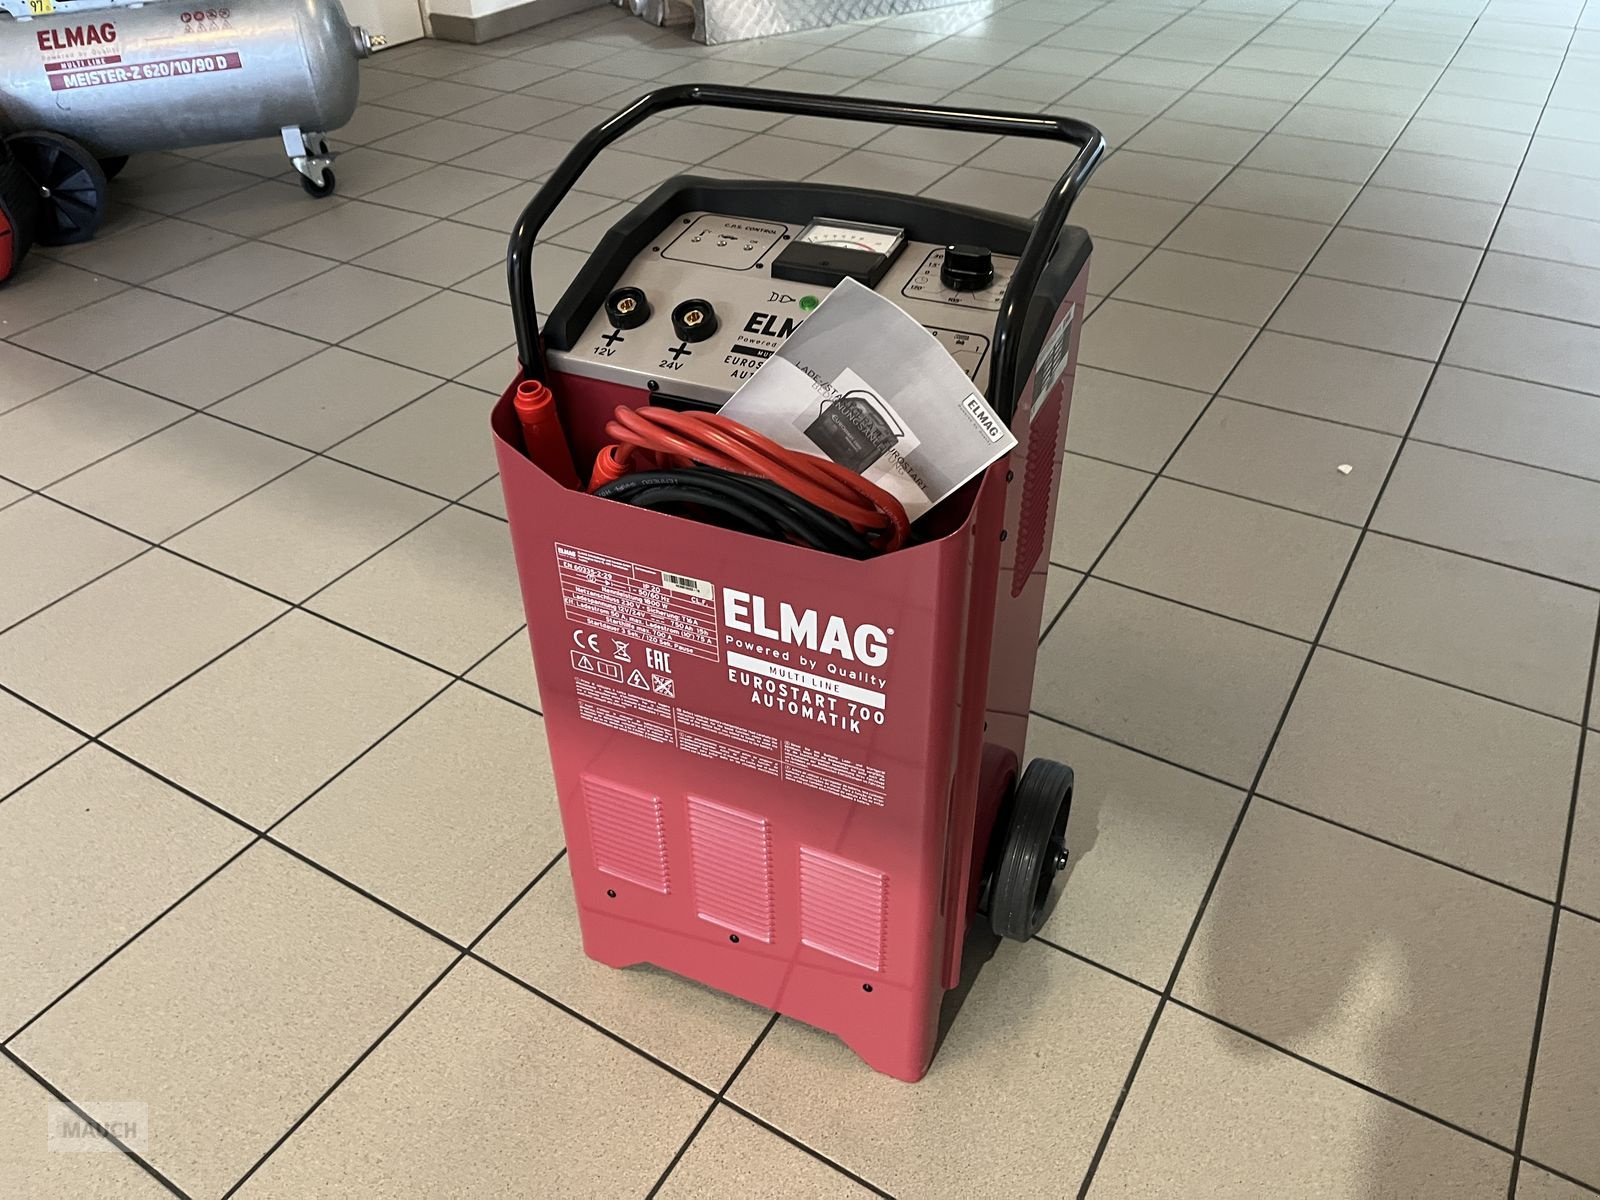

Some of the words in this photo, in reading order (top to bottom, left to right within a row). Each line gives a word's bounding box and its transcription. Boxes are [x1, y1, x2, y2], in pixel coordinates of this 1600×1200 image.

[36, 22, 116, 50] ELMAG
[60, 60, 85, 69] MULTI
[88, 58, 106, 66] LINE
[63, 66, 142, 88] MEISTER-Z
[142, 57, 214, 77] 620/10/90
[216, 56, 228, 69] D
[744, 226, 778, 235] CONTROL
[743, 312, 804, 339] ELM
[593, 346, 616, 357] 12V
[737, 335, 778, 348] Powered
[658, 360, 684, 371] 24V
[724, 355, 764, 370] EUROS
[968, 400, 998, 436] ELMAG
[572, 592, 616, 611] Ladespannung
[620, 599, 634, 608] 230
[638, 588, 659, 600] 50/60
[576, 600, 609, 615] Ladestrom
[645, 620, 679, 634] Ladestrom
[722, 587, 888, 667] ELMAG
[573, 629, 600, 654] CE
[652, 630, 665, 638] 700
[674, 643, 693, 653] Pause
[725, 634, 790, 662] Powered
[800, 655, 817, 670] by
[826, 663, 887, 689] Quality
[769, 666, 805, 684] MULTI
[812, 680, 840, 694] LINE
[728, 668, 838, 711] EUROSTART
[847, 702, 885, 725] 700
[751, 690, 860, 734] AUTOMATIK
